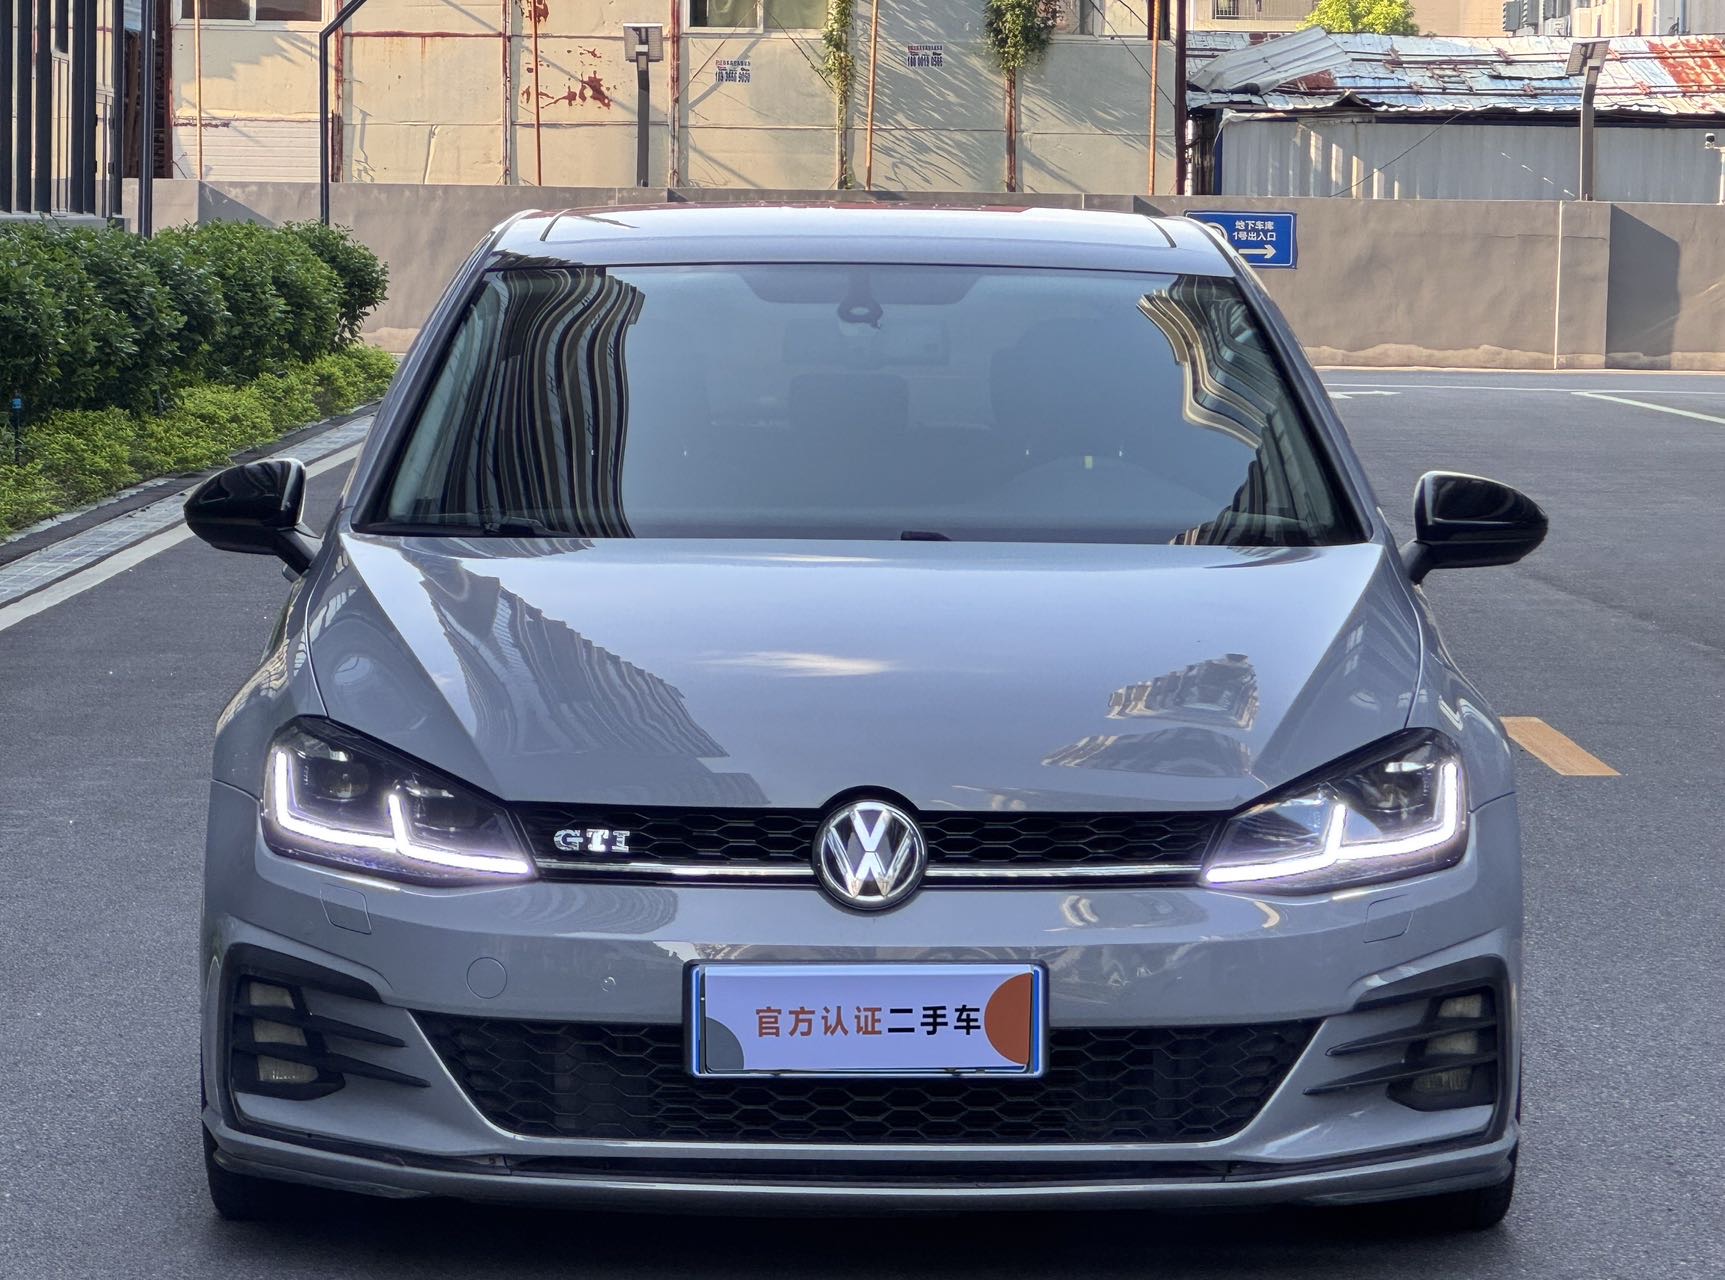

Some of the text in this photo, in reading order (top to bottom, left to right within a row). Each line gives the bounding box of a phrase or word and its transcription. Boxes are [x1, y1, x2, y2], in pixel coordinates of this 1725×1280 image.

[1235, 220, 1275, 230] 地下车库
[1232, 231, 1276, 241] 1号出入口
[553, 828, 631, 853] GTI
[755, 1004, 982, 1038] 官方认证二手车
